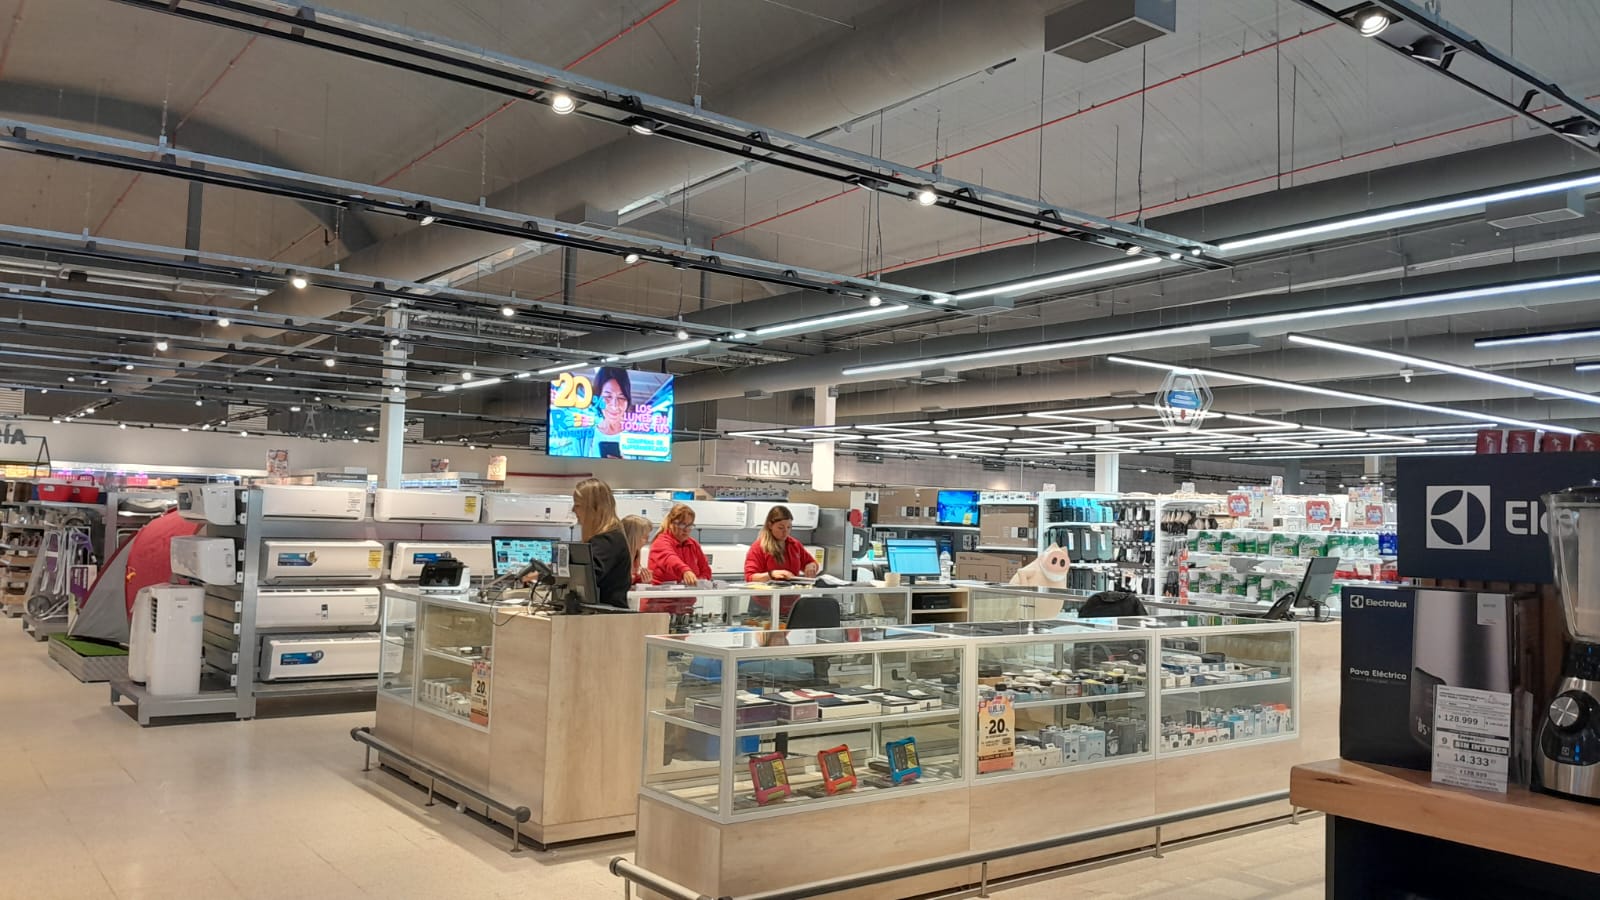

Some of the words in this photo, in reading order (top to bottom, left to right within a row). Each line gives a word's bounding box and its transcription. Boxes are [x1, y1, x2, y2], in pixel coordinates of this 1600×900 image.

[635, 404, 652, 413] LOS
[623, 412, 652, 423] LUNES
[656, 415, 667, 424] EN
[620, 421, 650, 432] TODAS
[653, 424, 670, 434] TUS
[0, 424, 27, 445] ÍA
[746, 459, 801, 477] TIENDA
[1365, 598, 1408, 608] Electrolux
[1349, 667, 1370, 676] Pava
[1371, 669, 1408, 680] Eléctrica
[1443, 713, 1479, 726] 128.999
[1441, 737, 1448, 745] 9
[1453, 753, 1490, 767] 14.333
